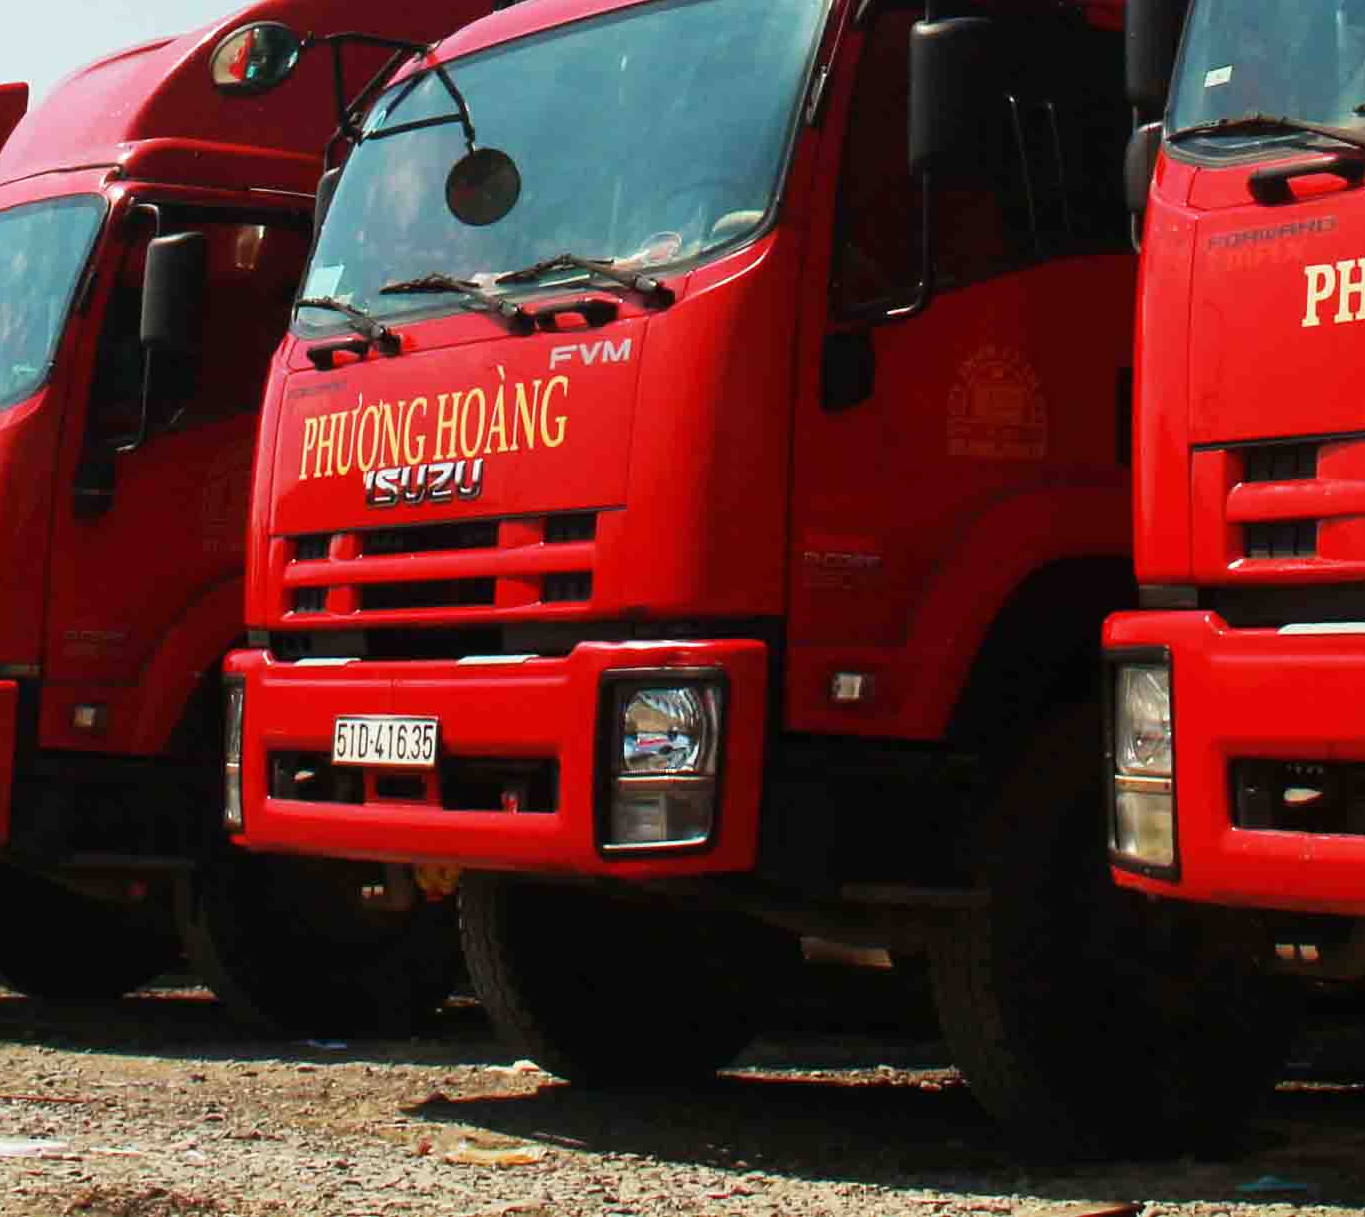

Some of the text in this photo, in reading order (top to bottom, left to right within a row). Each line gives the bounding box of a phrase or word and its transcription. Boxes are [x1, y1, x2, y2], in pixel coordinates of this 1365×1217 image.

[550, 338, 632, 370] FVM
[432, 365, 569, 462] HOÀNG
[364, 458, 484, 508] ISUZU
